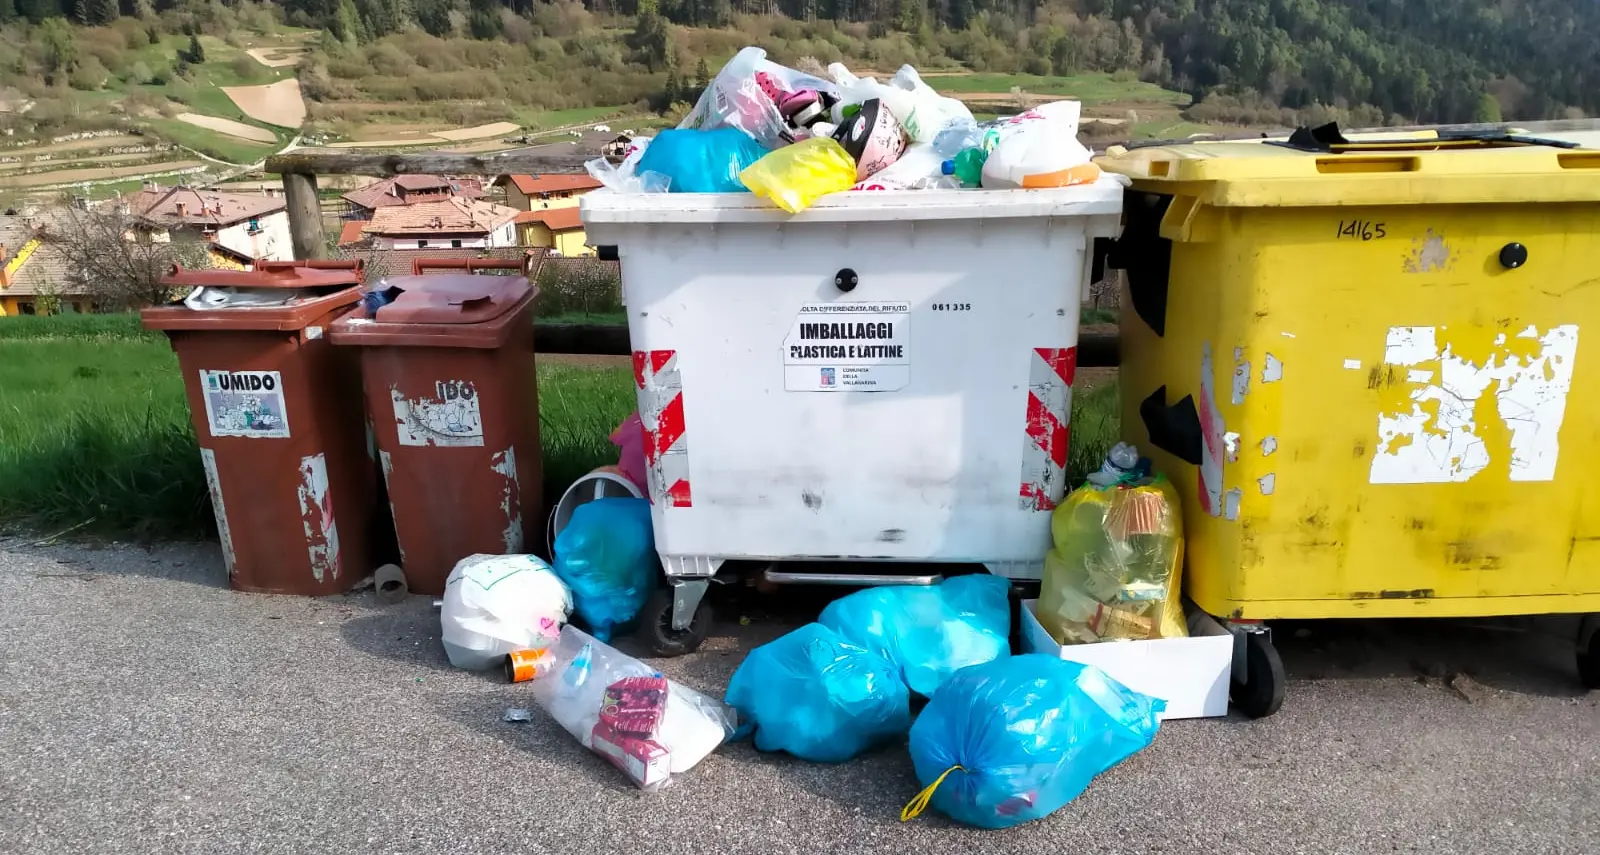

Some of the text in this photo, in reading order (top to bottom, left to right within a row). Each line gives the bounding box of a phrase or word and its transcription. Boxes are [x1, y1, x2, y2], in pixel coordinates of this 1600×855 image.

[1336, 220, 1387, 241] 14165
[932, 303, 971, 311] 061335
[800, 322, 893, 340] IMBALLAGGI
[790, 344, 903, 359] PLASTICA E LATTINE
[218, 374, 275, 391] UMIDO
